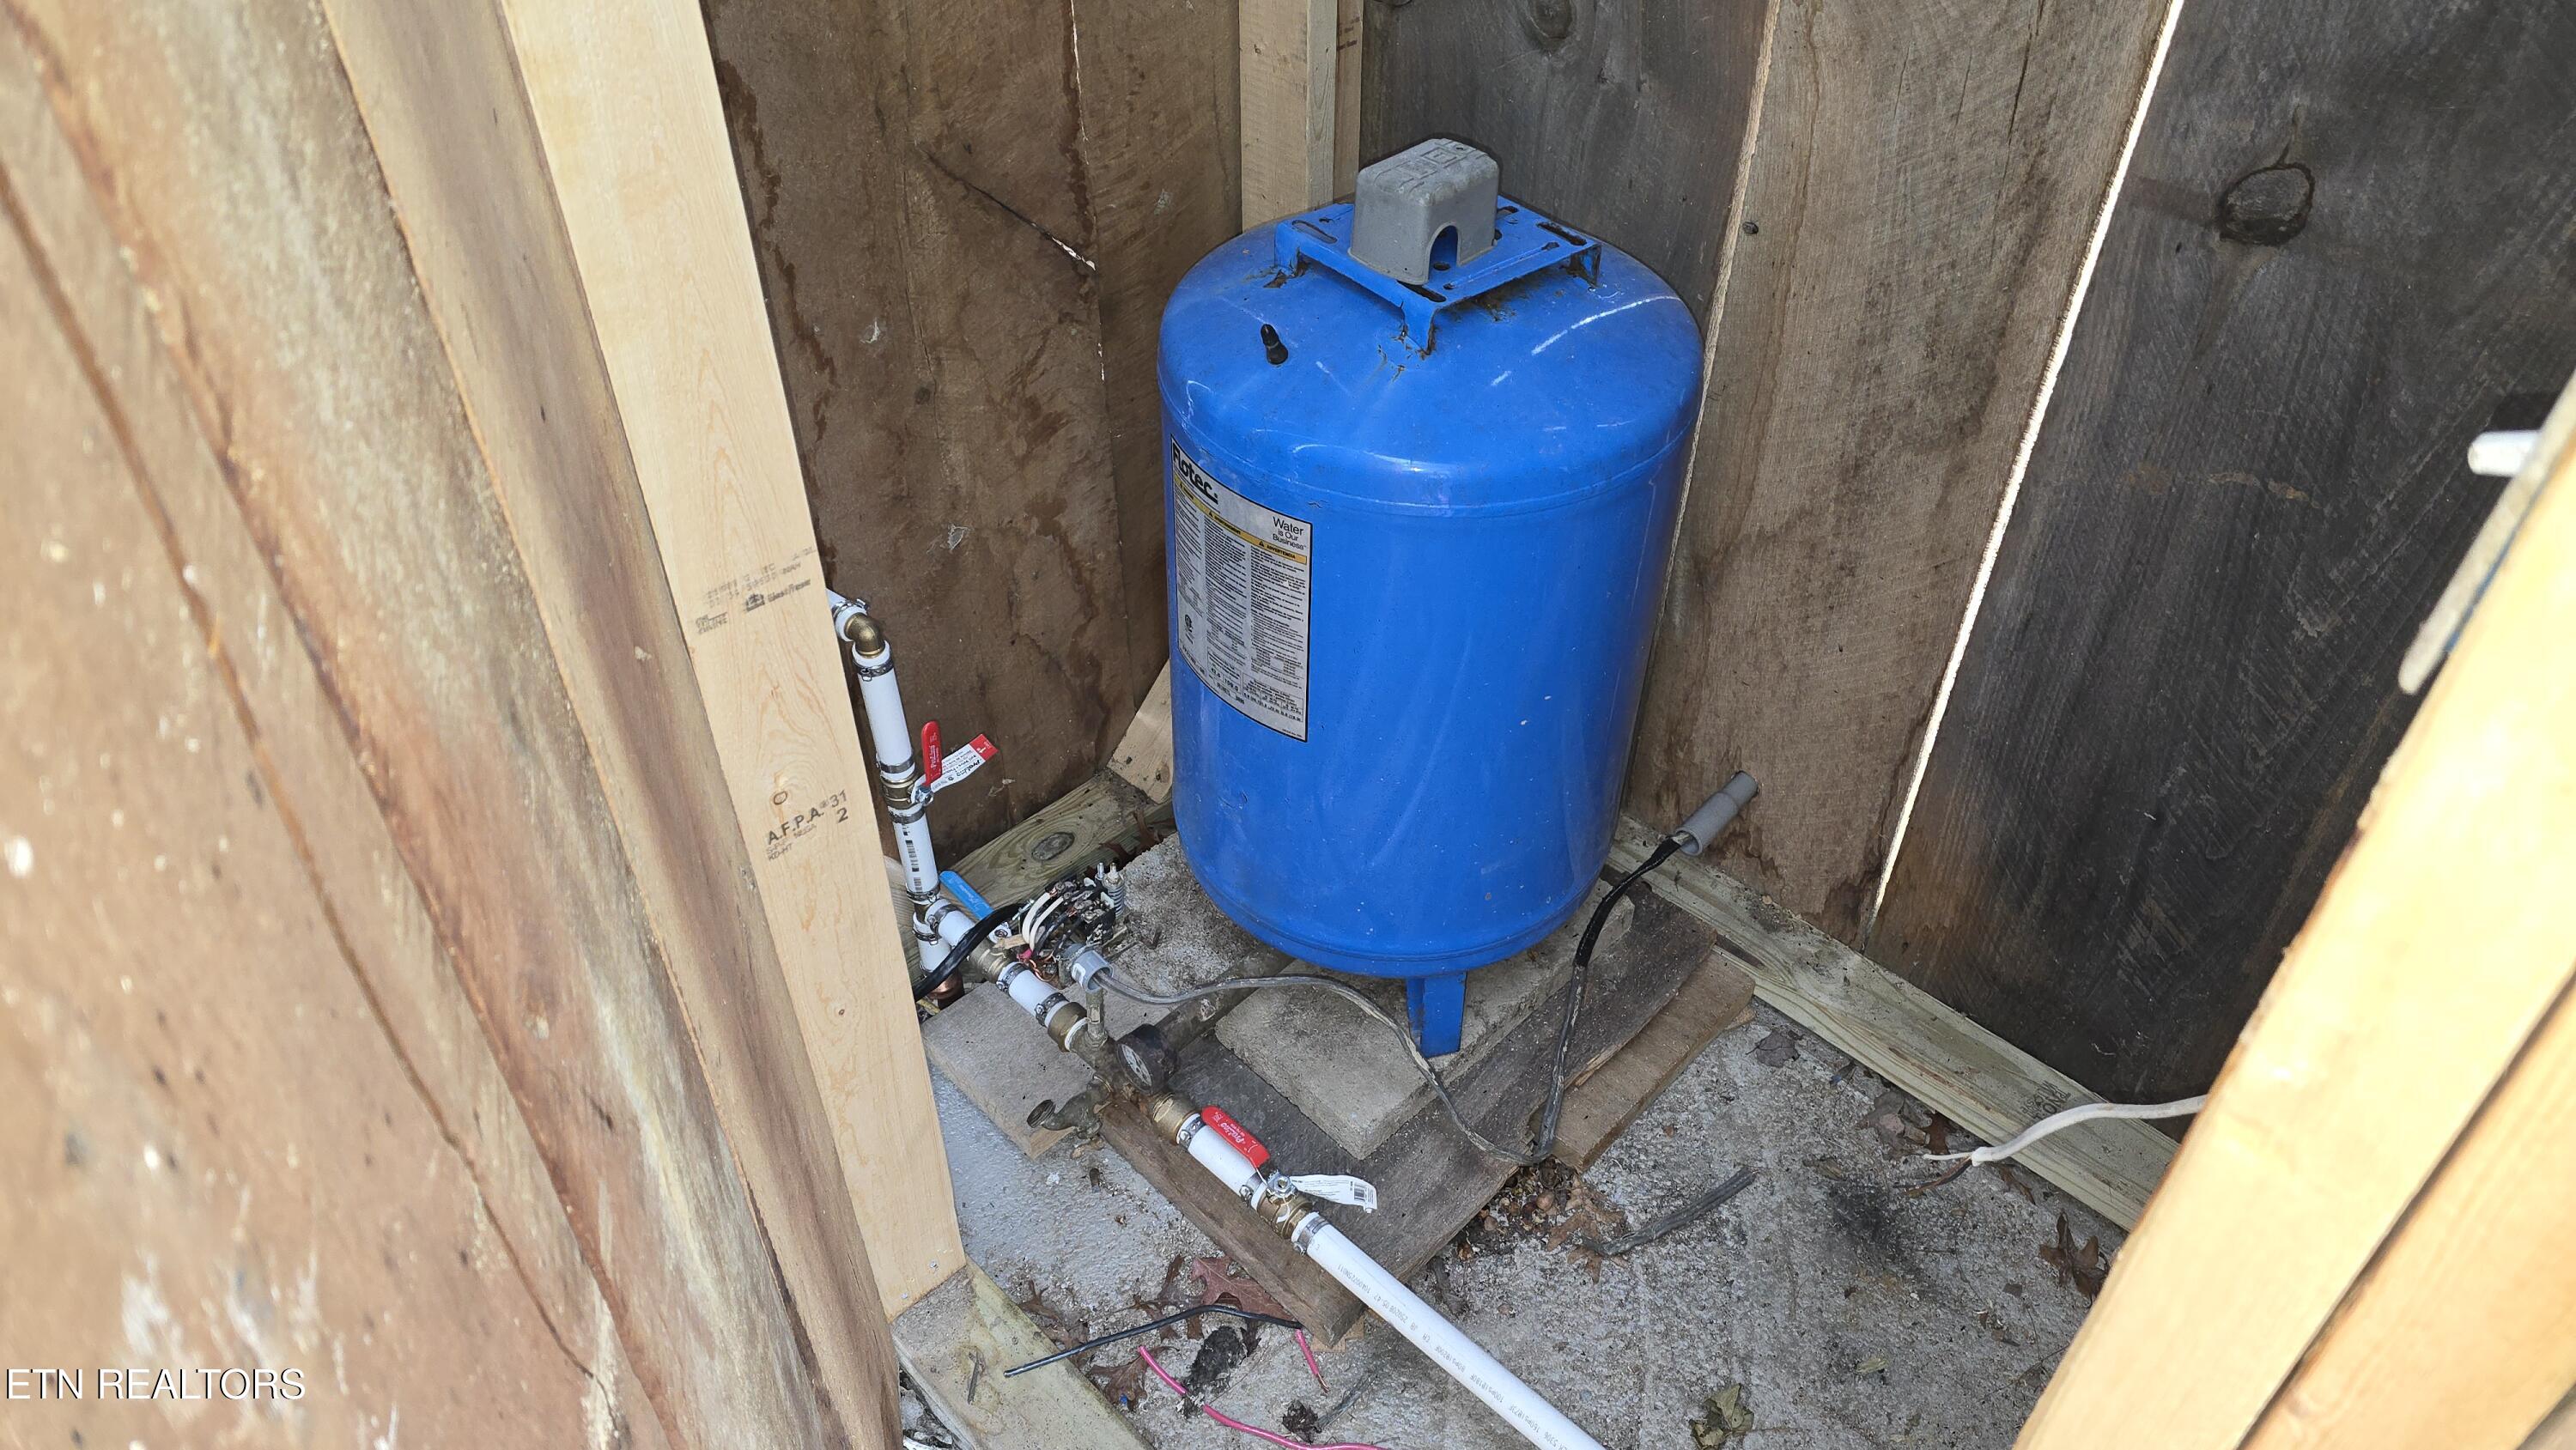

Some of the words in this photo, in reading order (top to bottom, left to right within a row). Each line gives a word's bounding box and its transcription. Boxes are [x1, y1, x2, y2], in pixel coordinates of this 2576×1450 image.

[1273, 516, 1304, 536] Water
[1285, 531, 1298, 541] Our
[836, 807, 848, 823] 2
